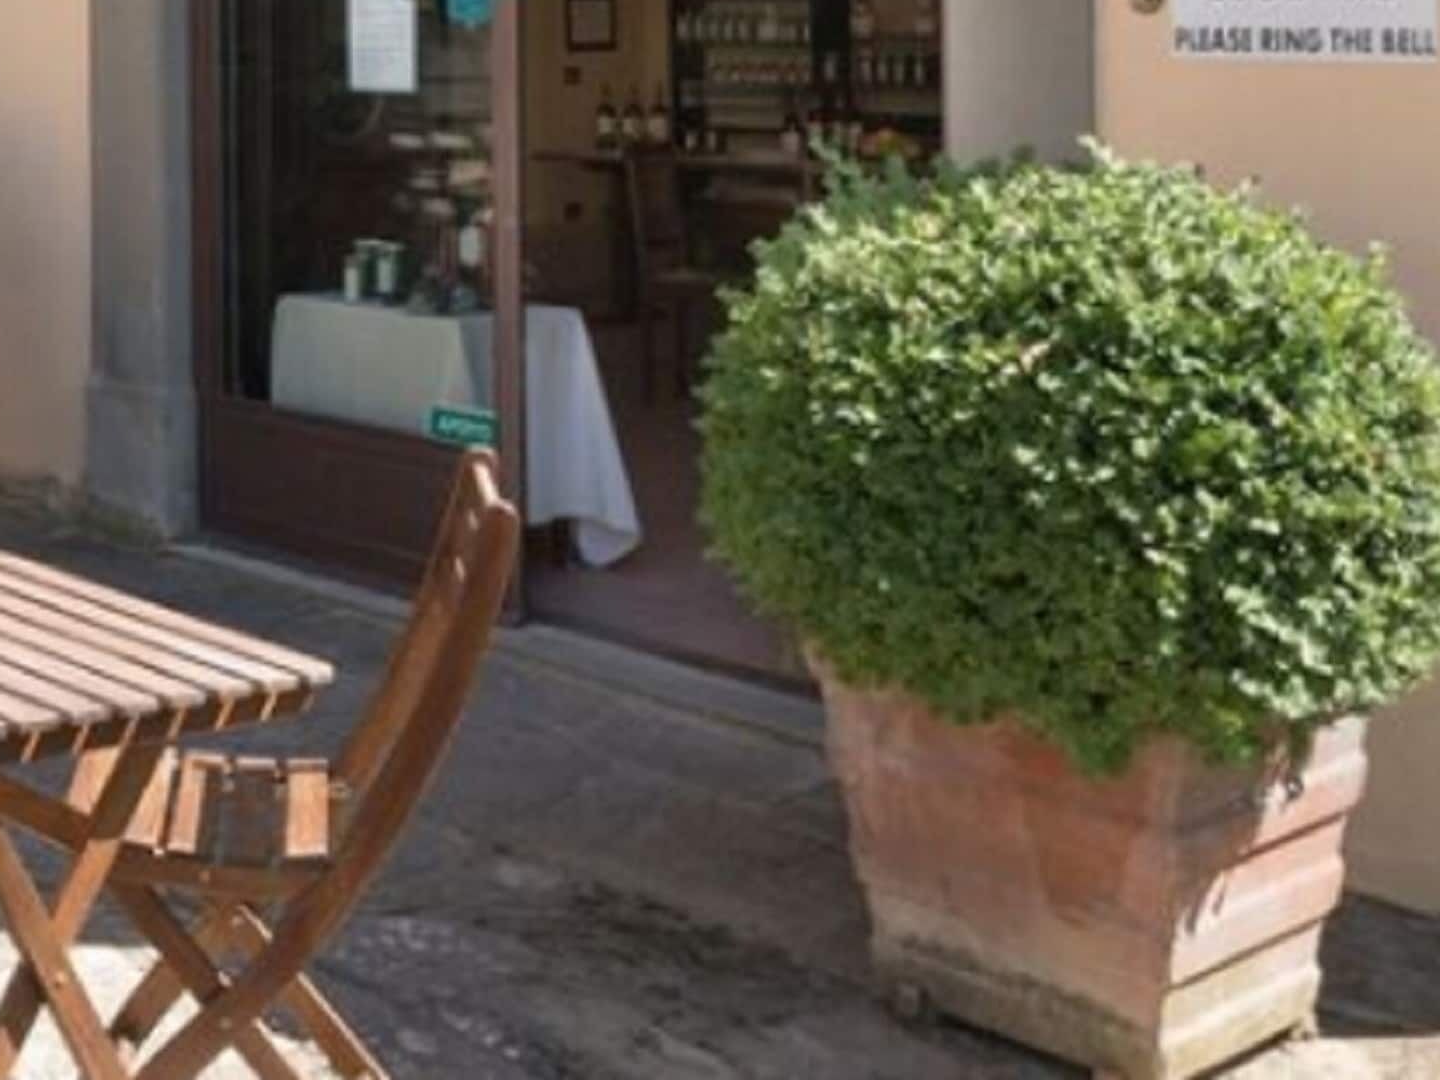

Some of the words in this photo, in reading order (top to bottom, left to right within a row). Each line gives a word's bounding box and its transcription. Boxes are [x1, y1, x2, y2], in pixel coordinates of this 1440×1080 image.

[1175, 27, 1252, 52] PLEASE
[1262, 27, 1322, 53] RING
[1330, 27, 1372, 53] THE
[1381, 27, 1436, 55] BELL
